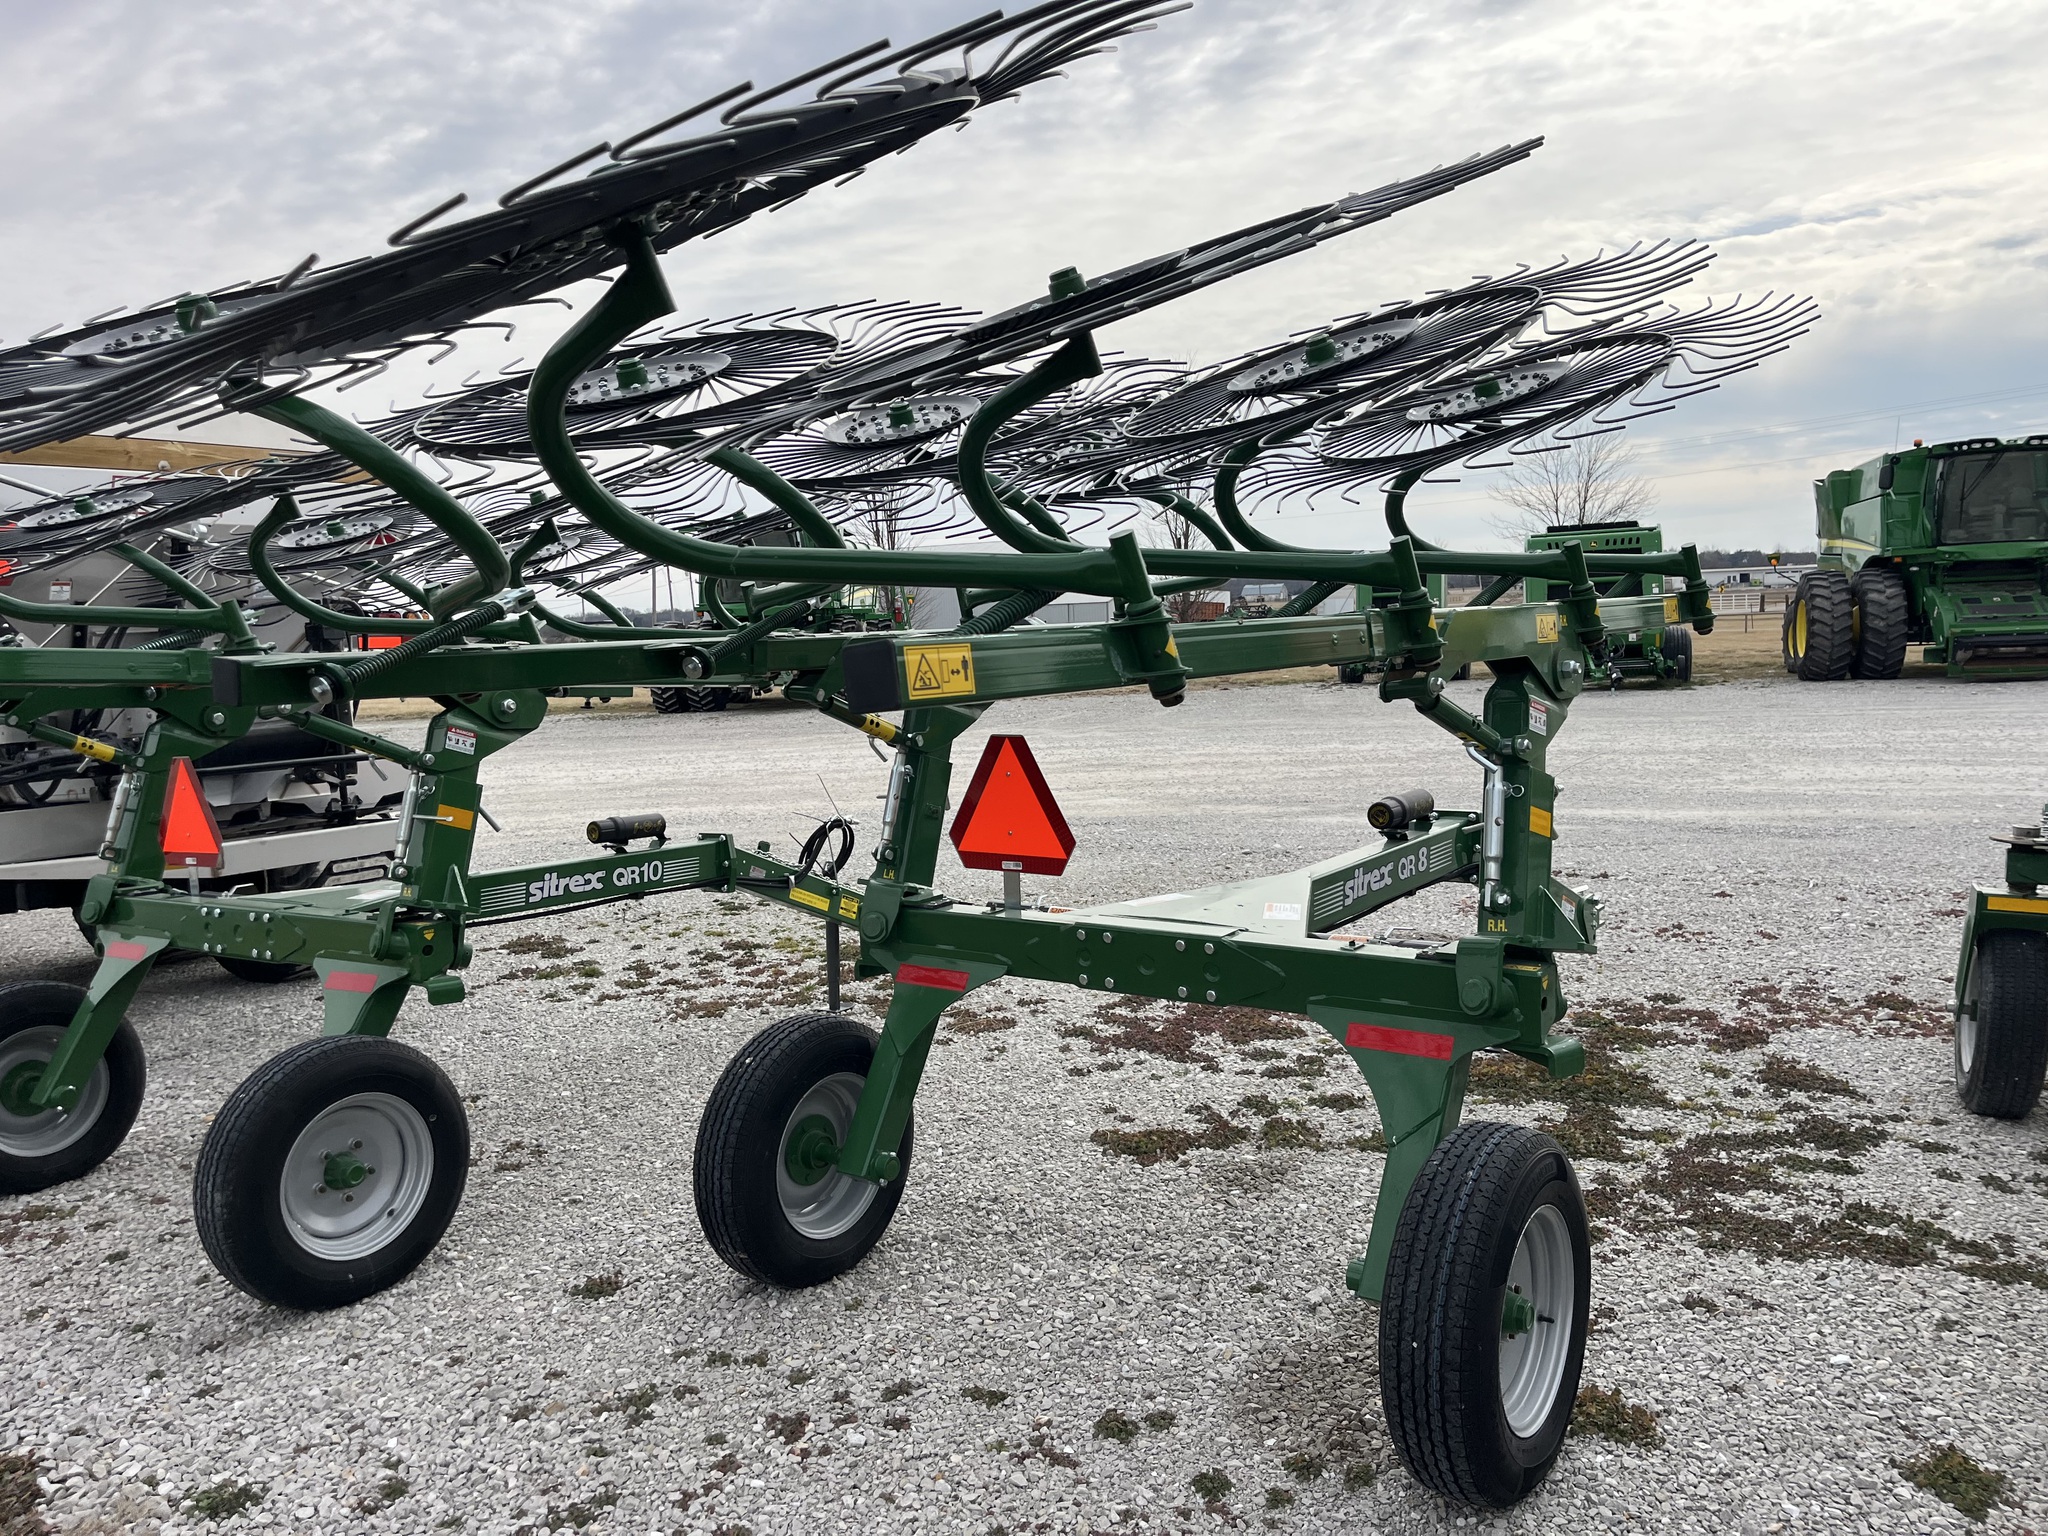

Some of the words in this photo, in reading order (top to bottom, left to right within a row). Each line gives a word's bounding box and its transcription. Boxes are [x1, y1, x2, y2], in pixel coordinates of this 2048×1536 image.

[528, 870, 606, 903] sitrex
[612, 860, 663, 887] QR10
[1344, 861, 1394, 906] sitrex
[1398, 854, 1416, 880] QR
[1418, 846, 1428, 872] 8
[1487, 919, 1508, 932] R.H.
